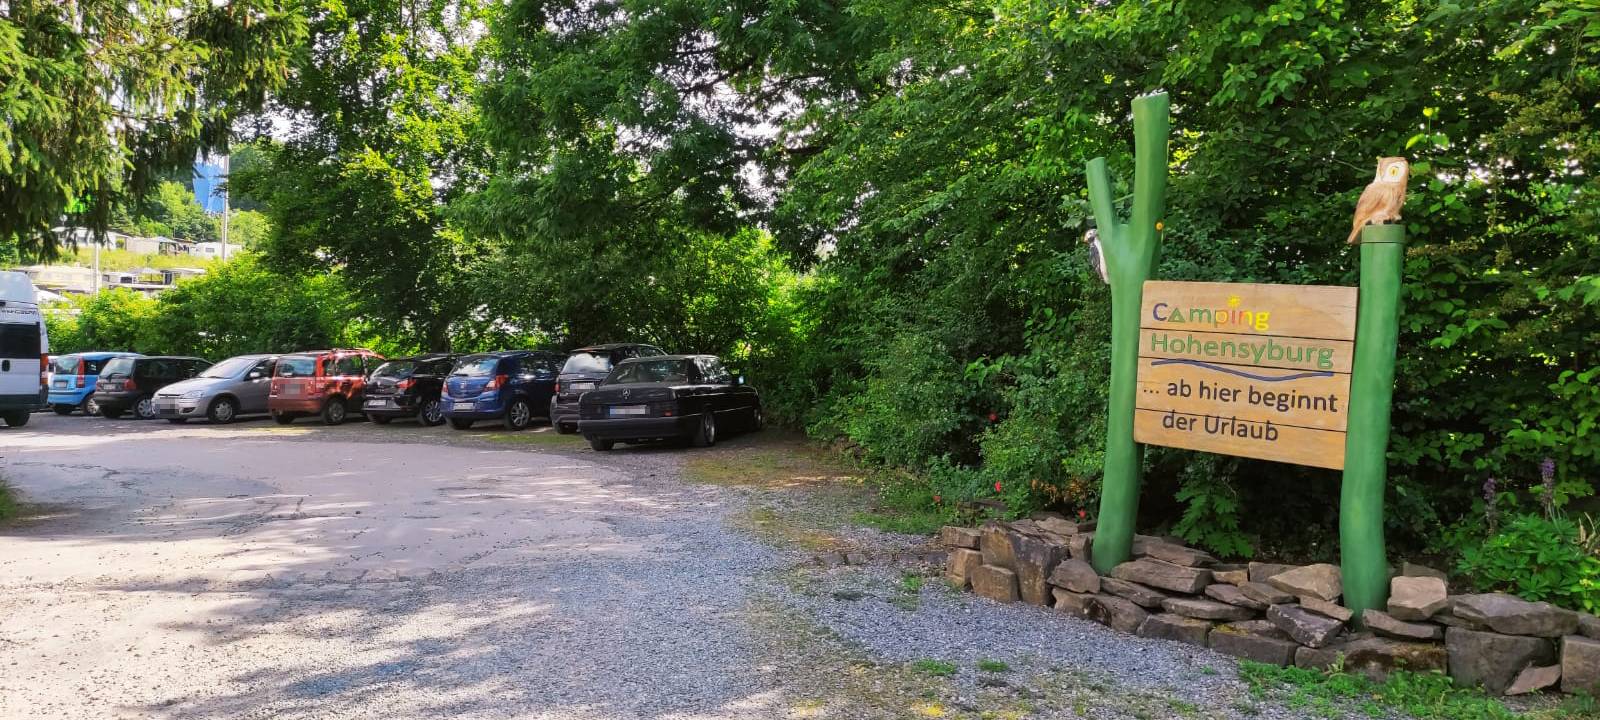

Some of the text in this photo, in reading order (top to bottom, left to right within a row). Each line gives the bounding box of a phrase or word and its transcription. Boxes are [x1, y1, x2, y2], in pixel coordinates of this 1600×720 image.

[1153, 295, 1270, 331] Camping
[1151, 333, 1334, 369] Hohensyburg
[1167, 379, 1192, 398] ab
[1199, 381, 1242, 402] hier
[1248, 385, 1338, 412] beginnt
[1162, 409, 1279, 441] der Urlaub
